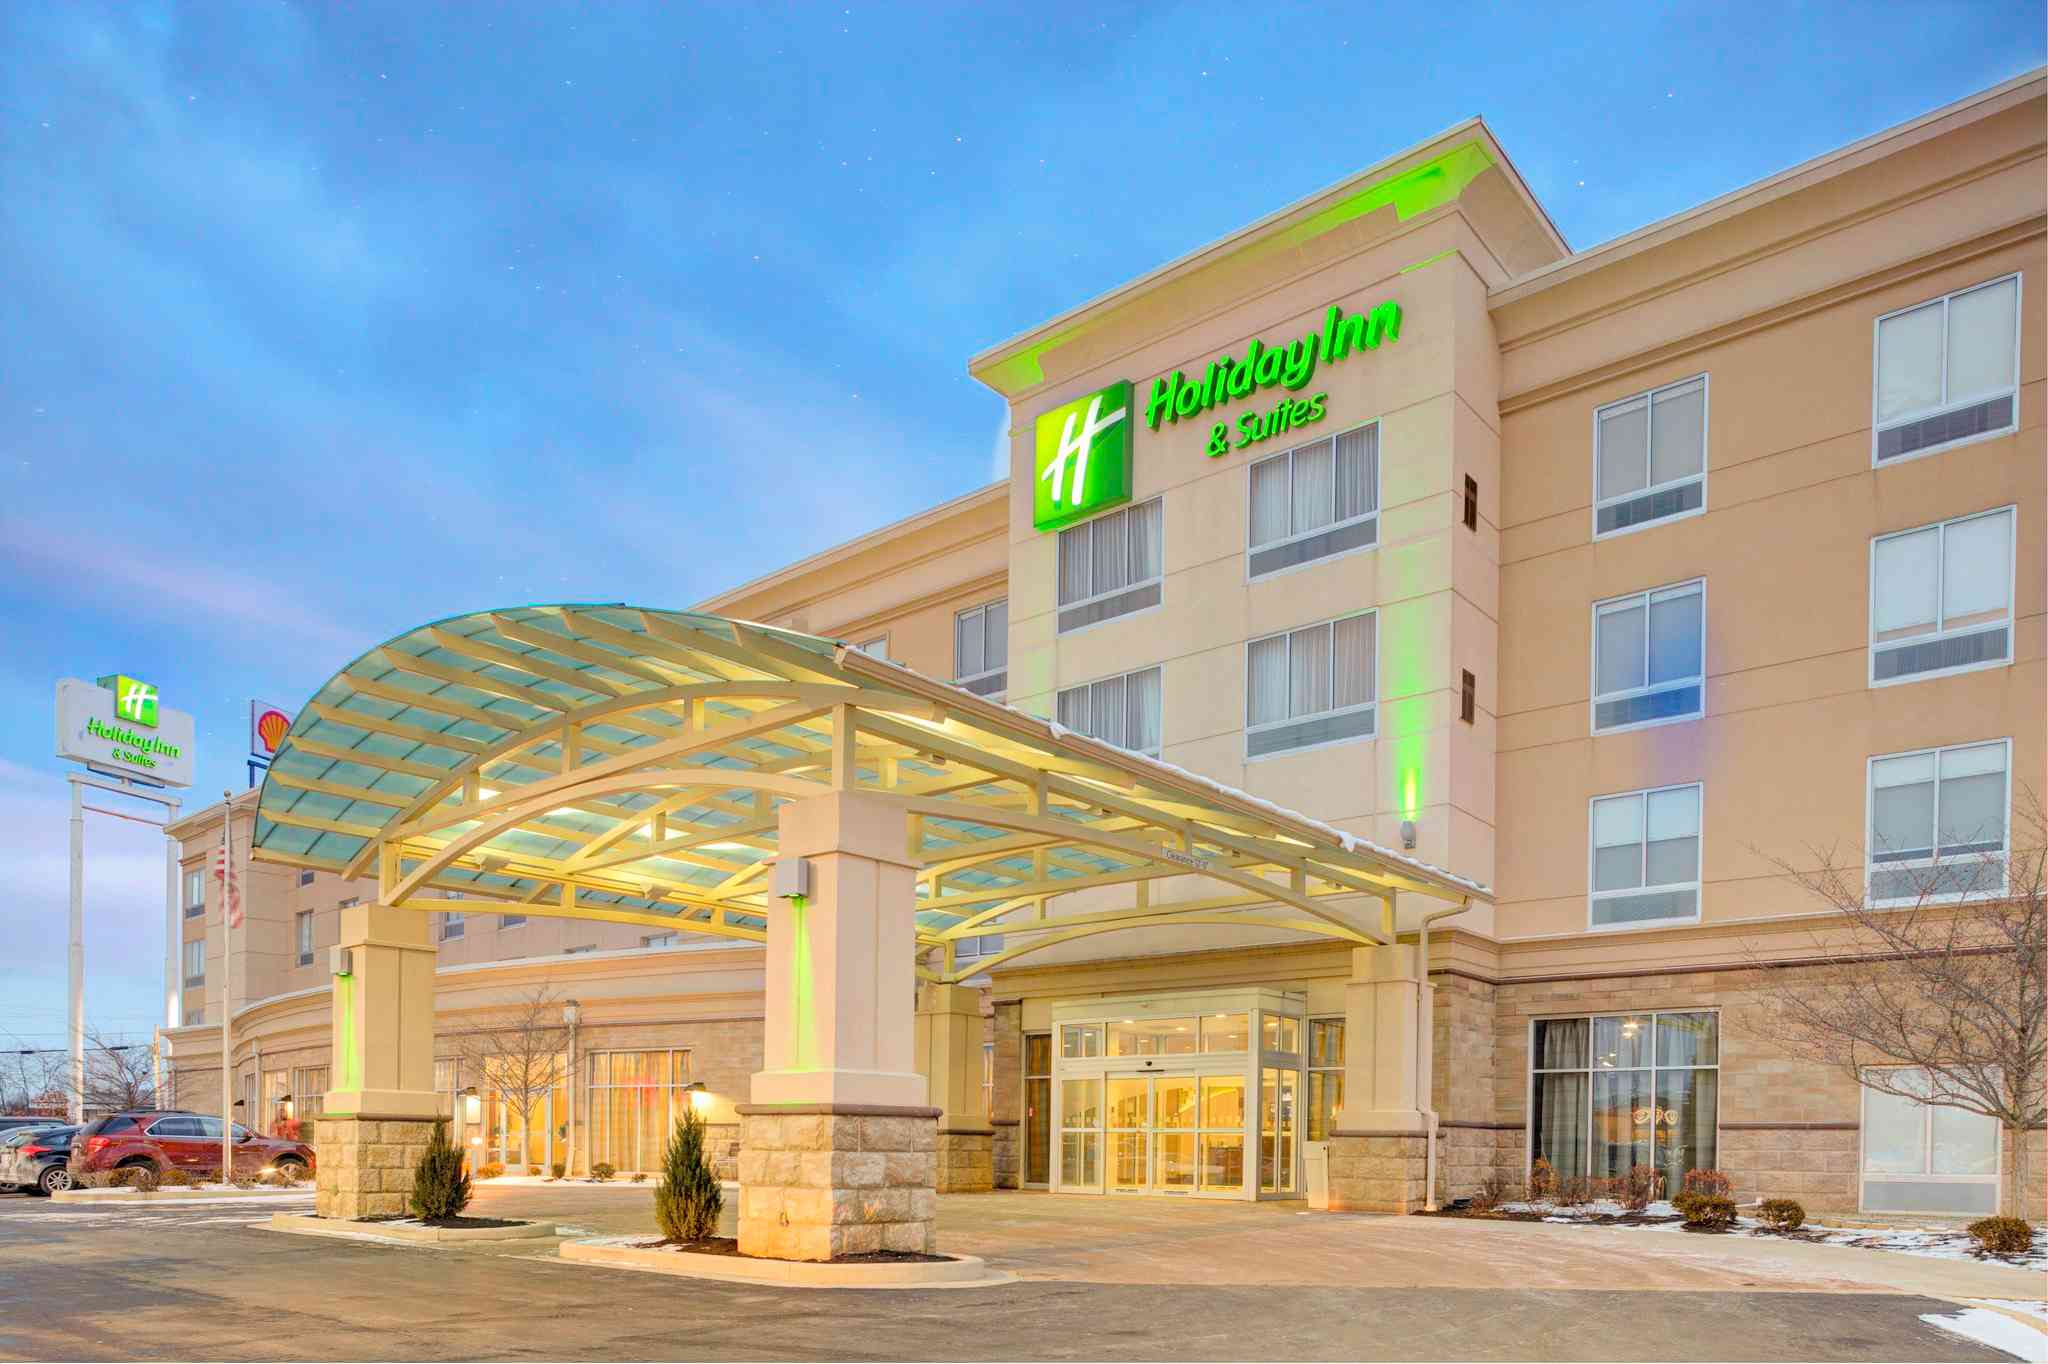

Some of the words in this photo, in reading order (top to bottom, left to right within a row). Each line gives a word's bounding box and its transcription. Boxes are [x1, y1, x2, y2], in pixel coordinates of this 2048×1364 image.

[1145, 333, 1319, 430] Holiday
[1319, 300, 1402, 365] Inn
[1205, 422, 1230, 458] &
[1235, 392, 1328, 450] Suites
[87, 716, 153, 754] Holiday
[152, 736, 182, 759] Inn
[112, 748, 121, 760] &
[123, 751, 156, 768] Suites
